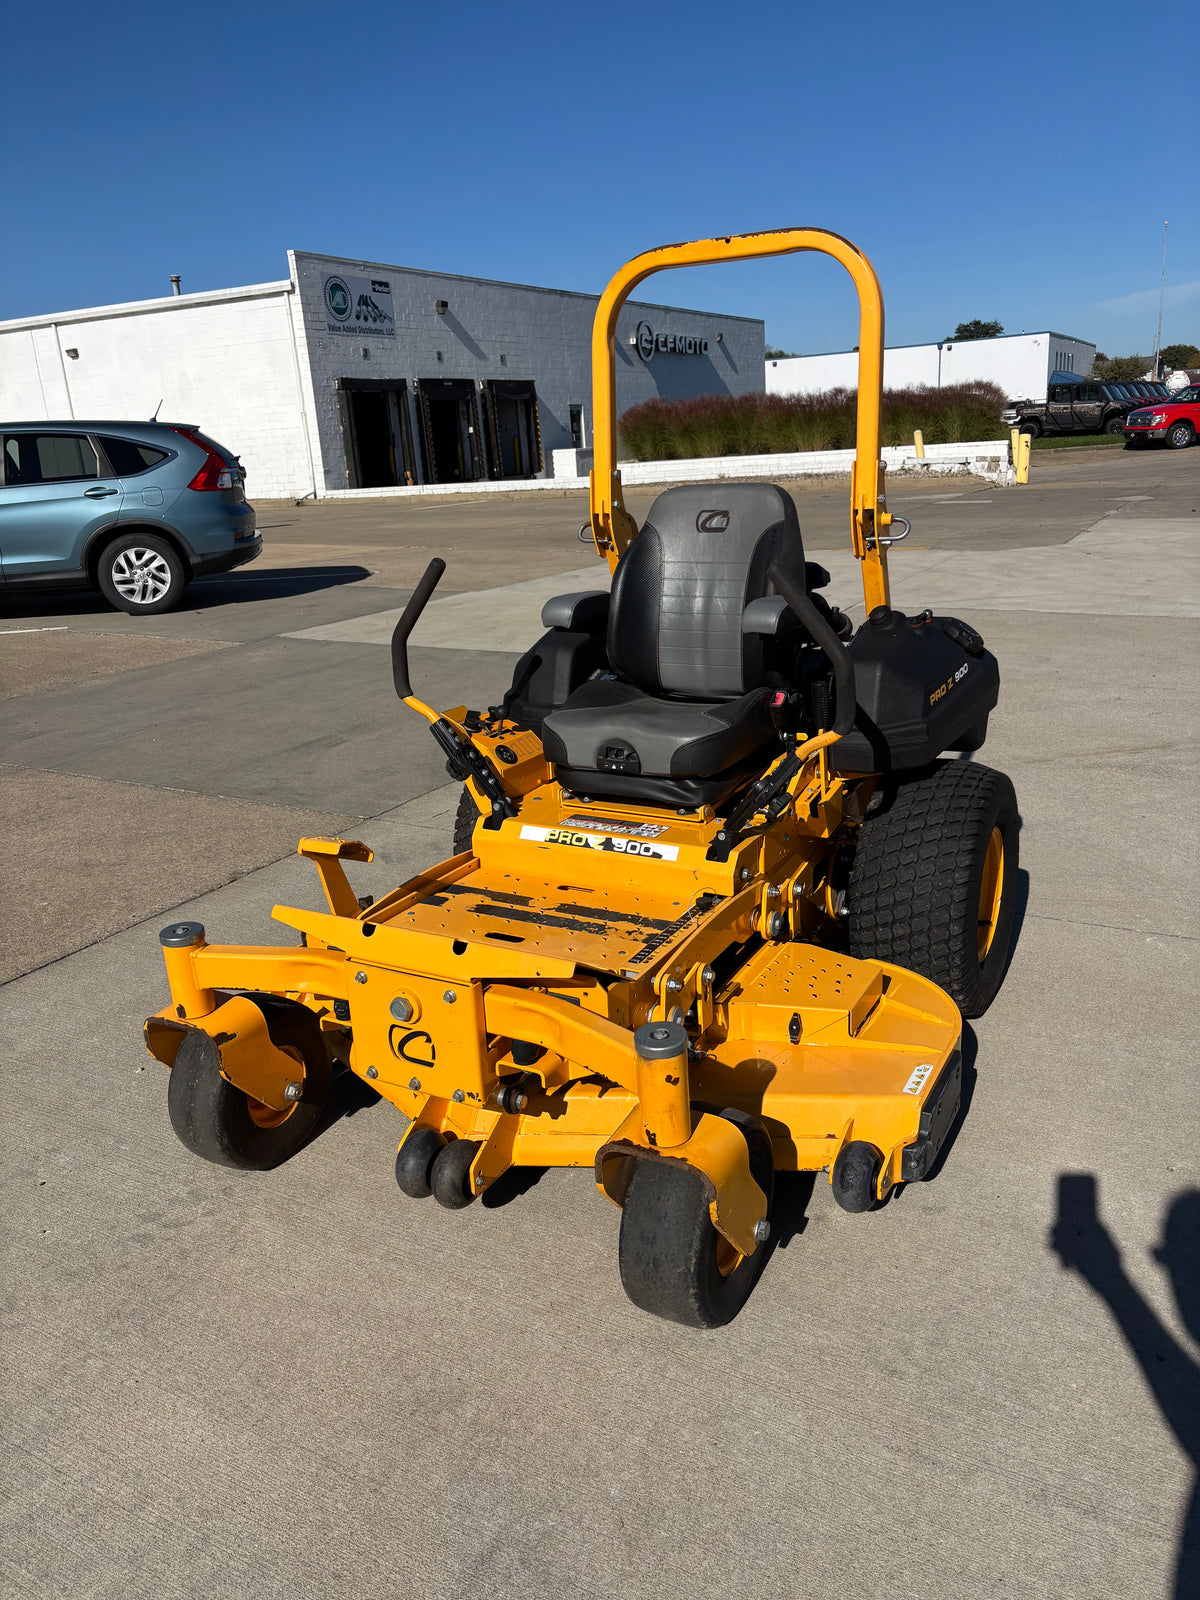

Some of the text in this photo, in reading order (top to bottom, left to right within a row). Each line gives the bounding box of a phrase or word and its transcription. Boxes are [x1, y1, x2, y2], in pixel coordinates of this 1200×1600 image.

[327, 323, 341, 332] Value
[342, 325, 358, 333] Added
[386, 328, 395, 336] LLC
[656, 333, 709, 355] CFMOTO
[930, 662, 969, 706] PRO Z 900
[545, 830, 654, 856] PRO Z 900
